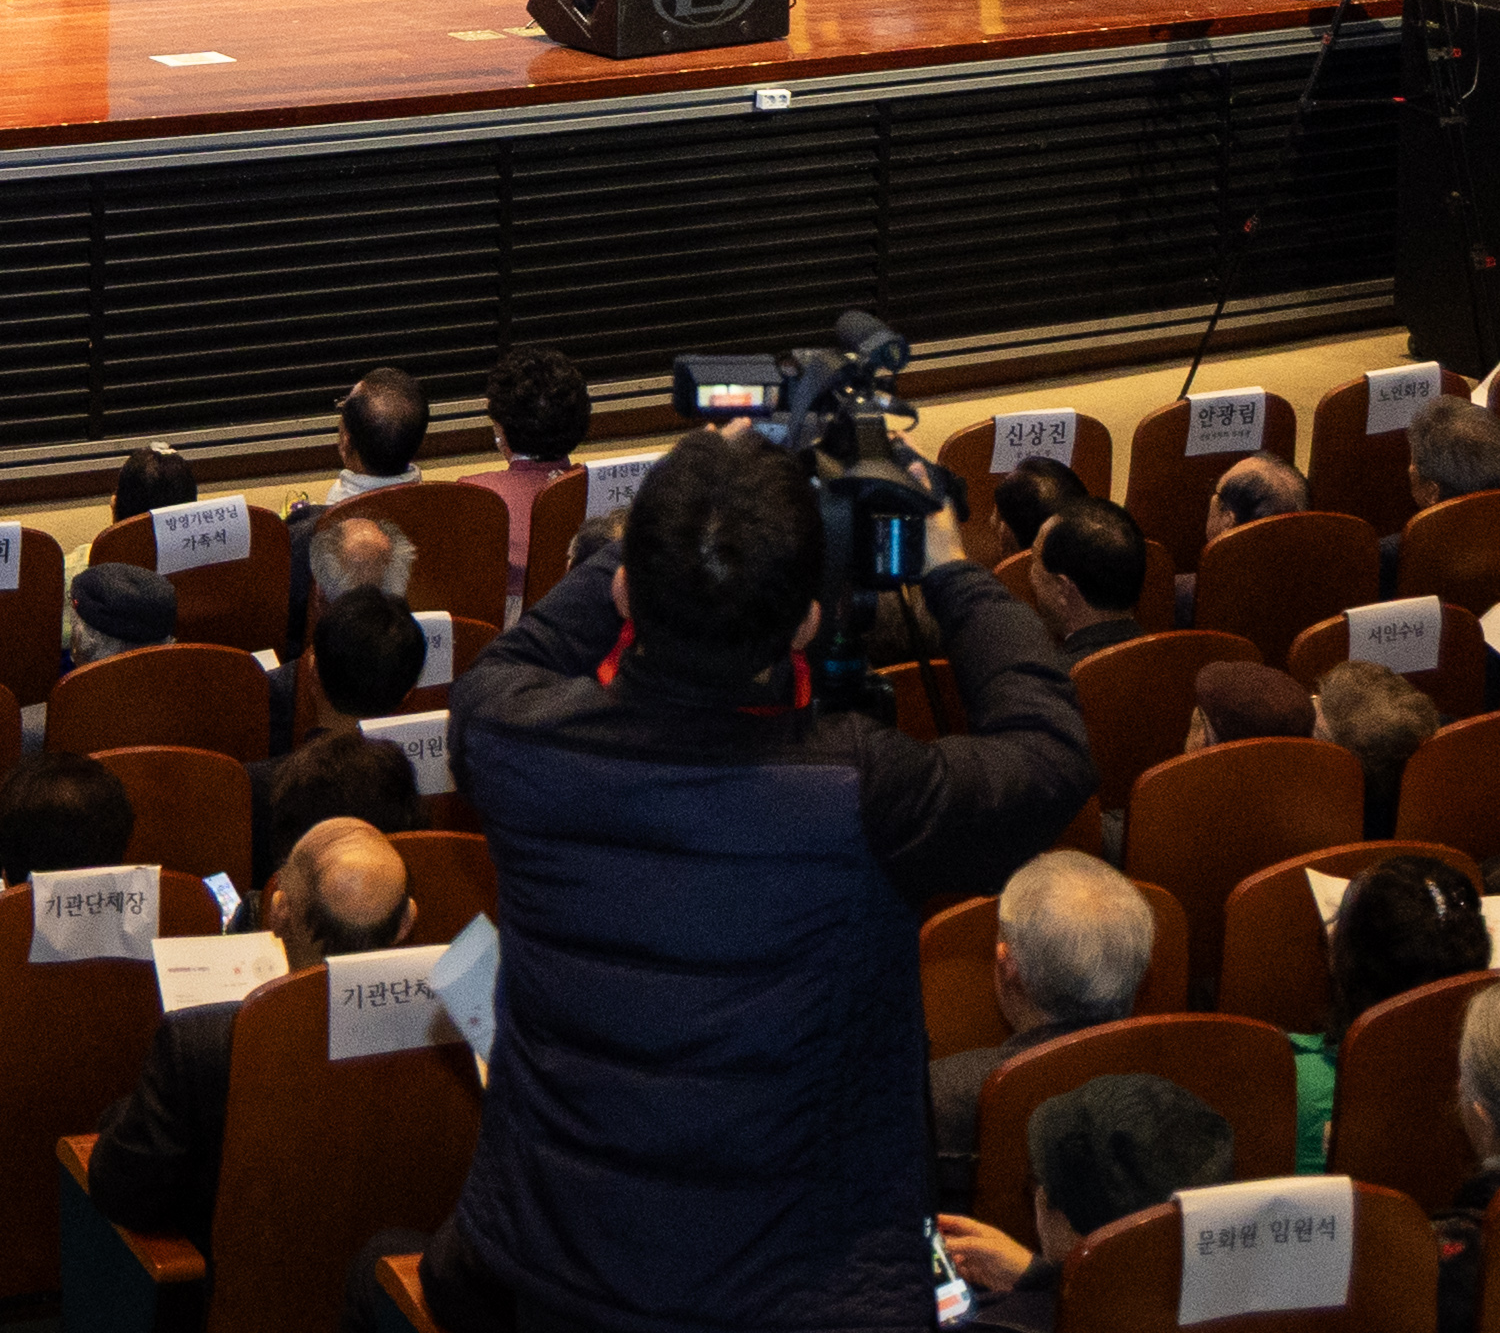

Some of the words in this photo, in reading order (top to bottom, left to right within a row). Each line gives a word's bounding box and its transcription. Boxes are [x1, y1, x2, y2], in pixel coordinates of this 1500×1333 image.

[1378, 380, 1430, 402] 노인회장
[1198, 401, 1256, 429] 안광림
[1006, 421, 1066, 447] 신상진
[608, 486, 635, 503] 가족
[183, 529, 227, 551] 가족석
[407, 737, 443, 760] 의원
[46, 890, 148, 919] 기관단체장
[342, 978, 436, 1010] 기관단체
[1197, 1222, 1257, 1257] 문화원
[1270, 1213, 1337, 1246] 임원석
